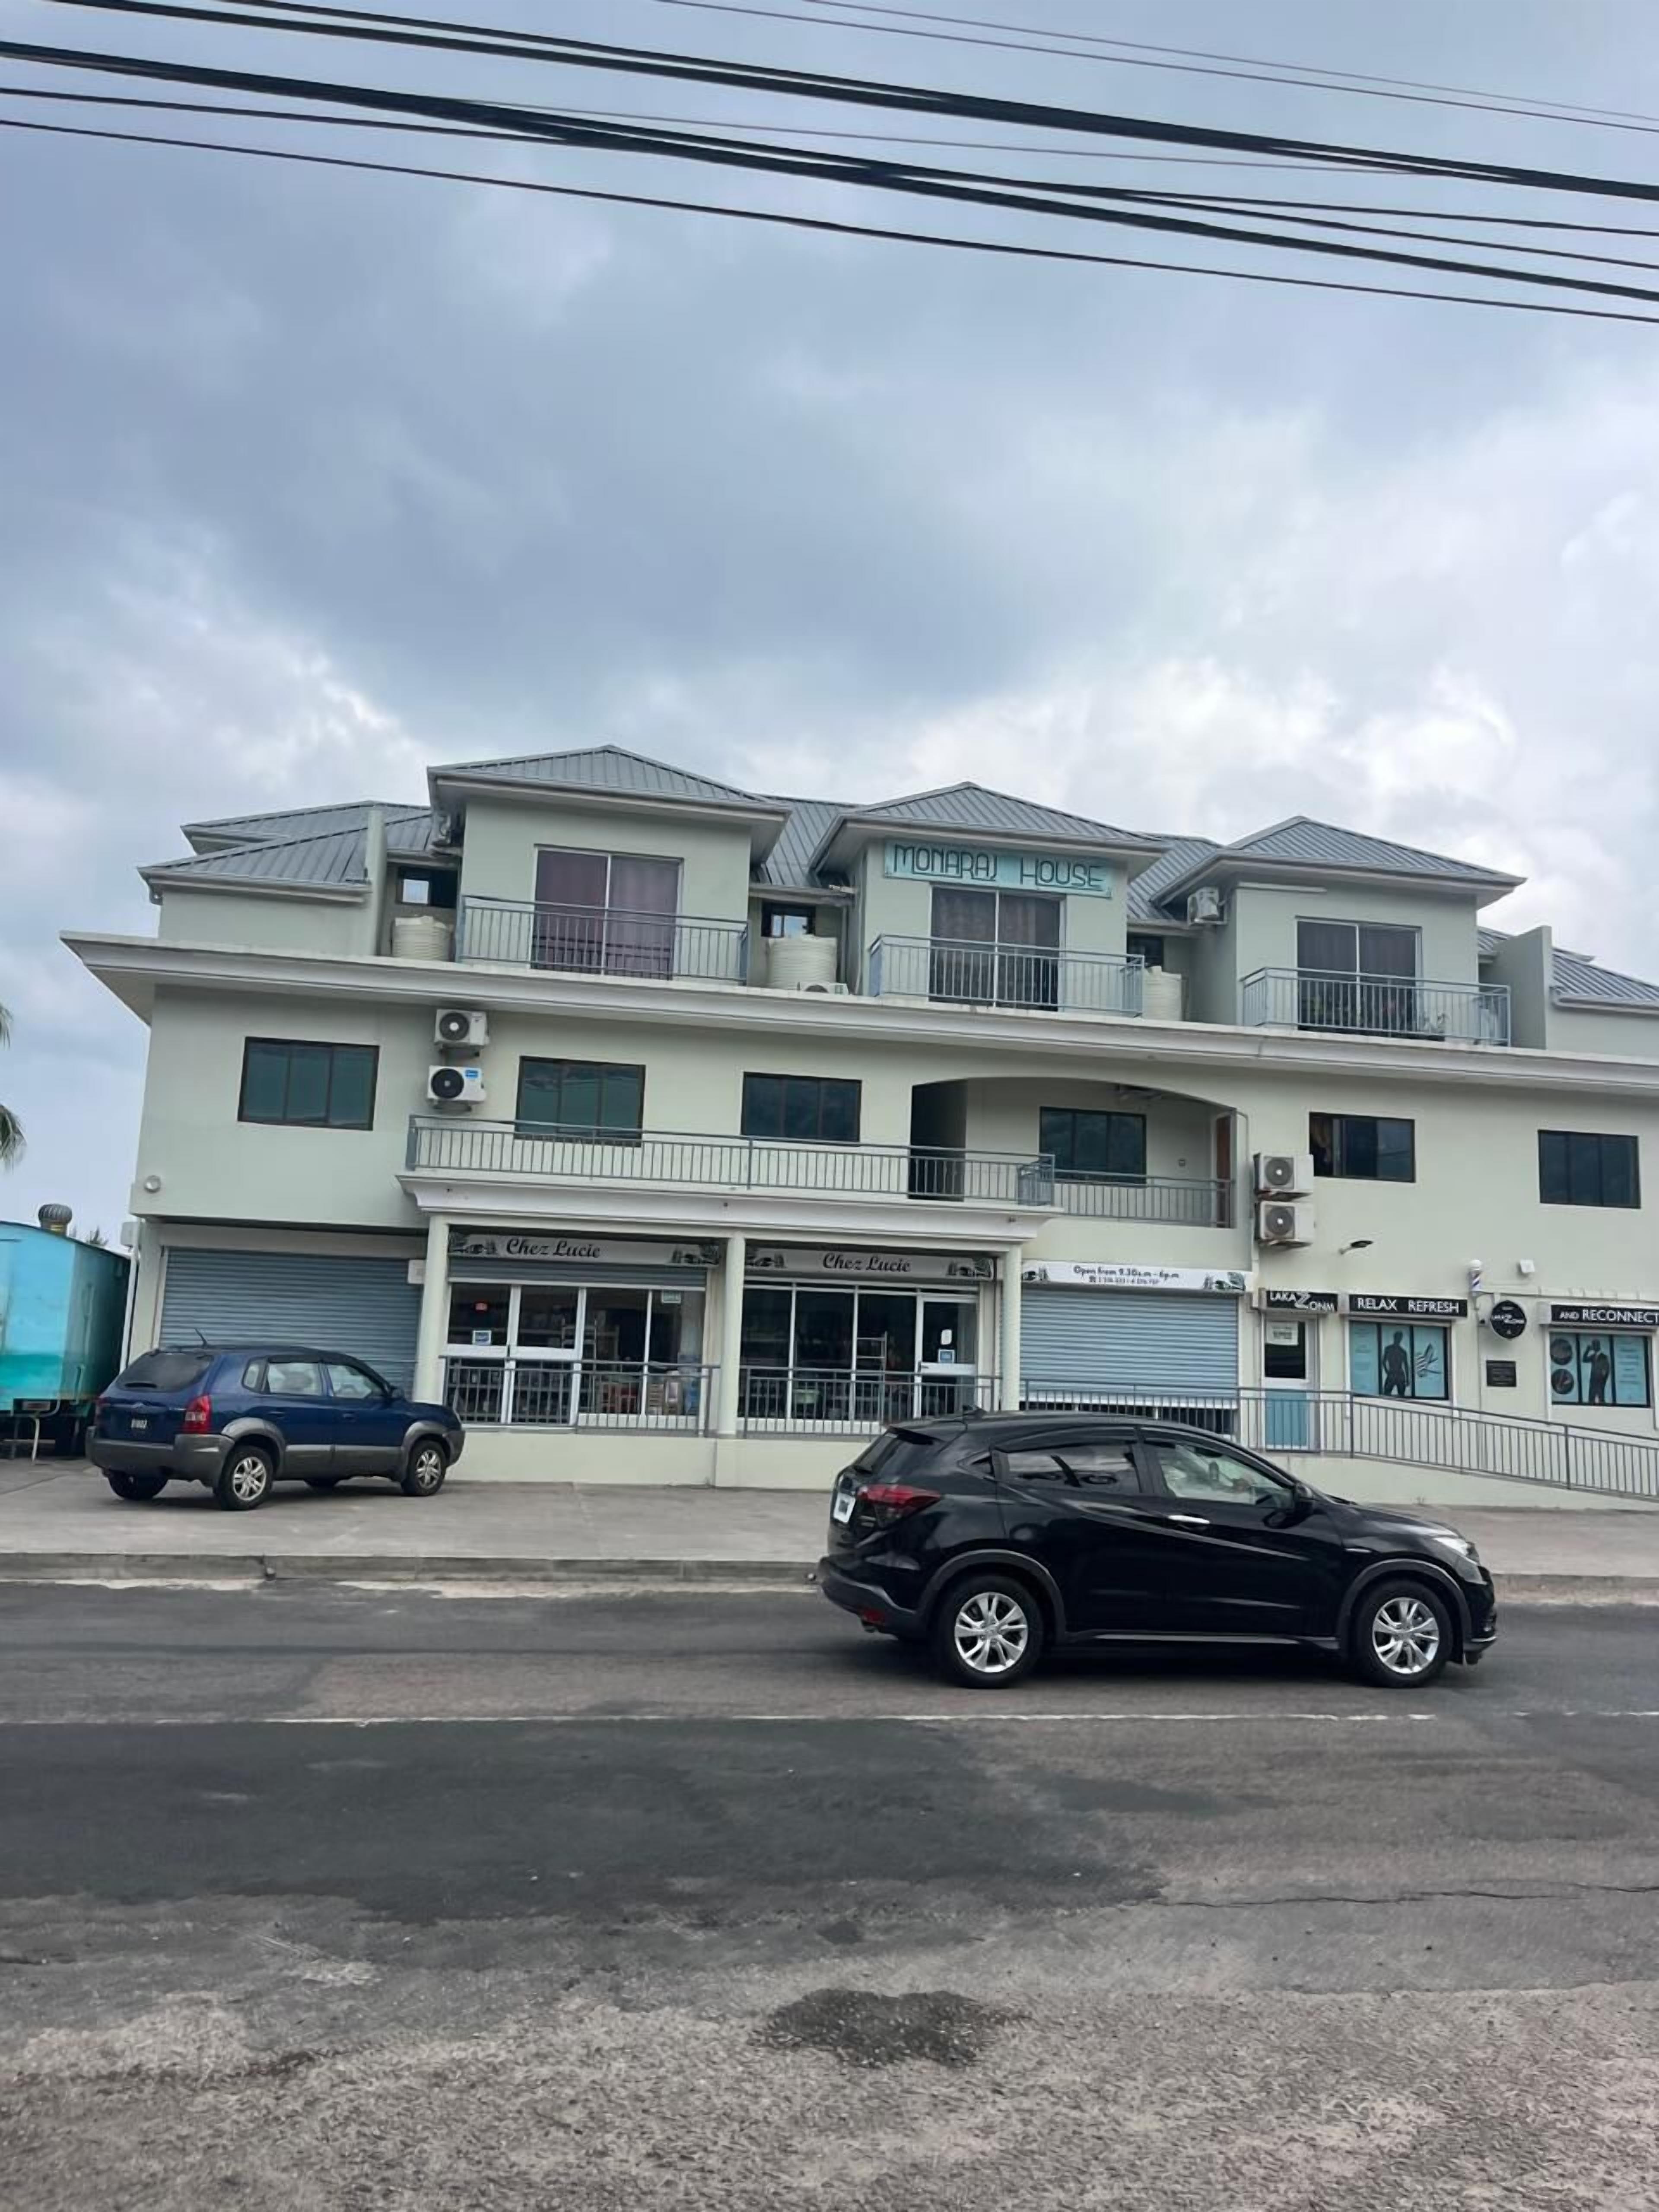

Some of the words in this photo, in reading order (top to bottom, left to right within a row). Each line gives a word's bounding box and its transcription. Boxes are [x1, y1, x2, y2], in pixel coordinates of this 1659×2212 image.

[894, 843, 997, 881] MONARAJ
[1020, 857, 1104, 891] HOUSE
[506, 1238, 549, 1255] Chez
[553, 1240, 600, 1258] Lucie
[823, 1252, 862, 1270] Chez
[865, 1256, 911, 1272] Lucie
[1073, 1265, 1096, 1278] Open
[1098, 1266, 1116, 1275] from
[1357, 1297, 1398, 1311] RELAX
[1408, 1300, 1459, 1314] REFRESH
[1560, 1311, 1580, 1320] AND
[1583, 1309, 1659, 1323] RECONNECT
